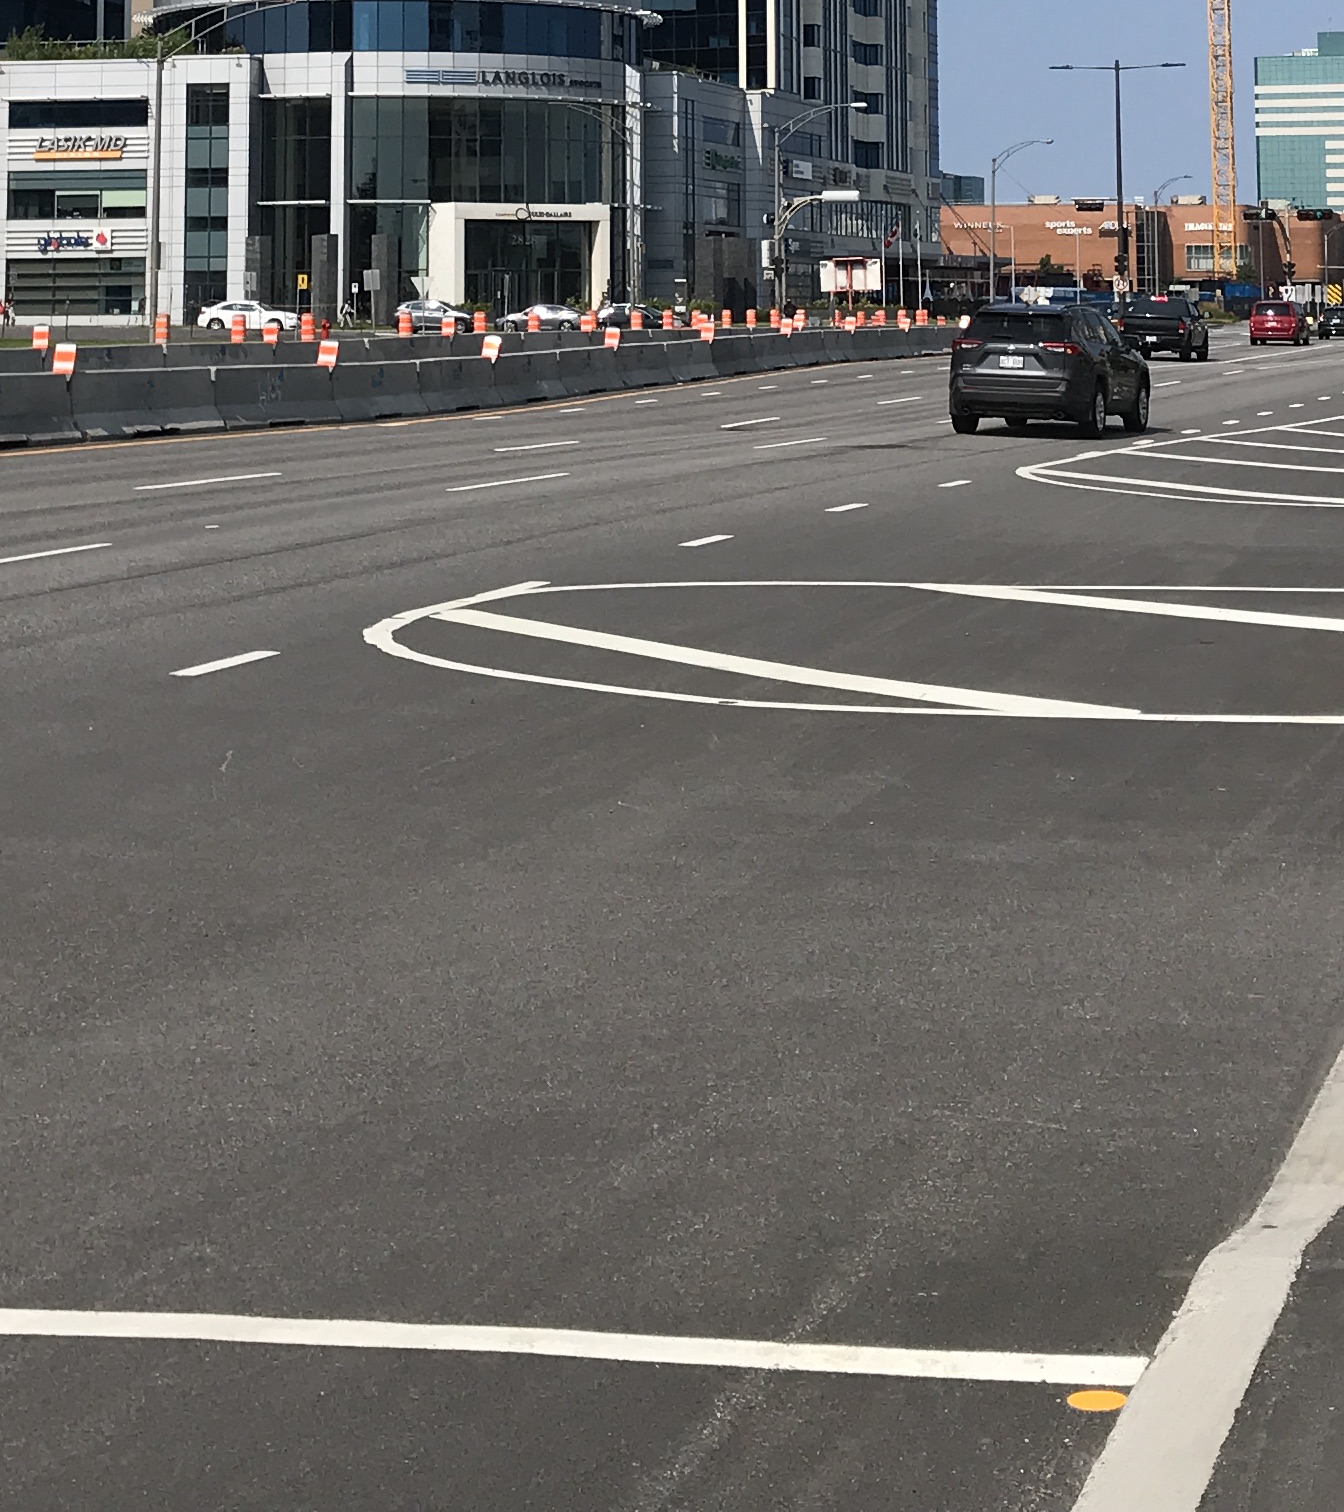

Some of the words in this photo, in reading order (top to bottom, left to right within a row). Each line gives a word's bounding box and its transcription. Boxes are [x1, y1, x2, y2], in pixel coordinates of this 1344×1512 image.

[481, 70, 565, 87] LANGLOIS
[36, 135, 90, 151] LASIK
[94, 134, 126, 151] MD
[1044, 220, 1076, 229] sports
[1056, 226, 1093, 235] experts
